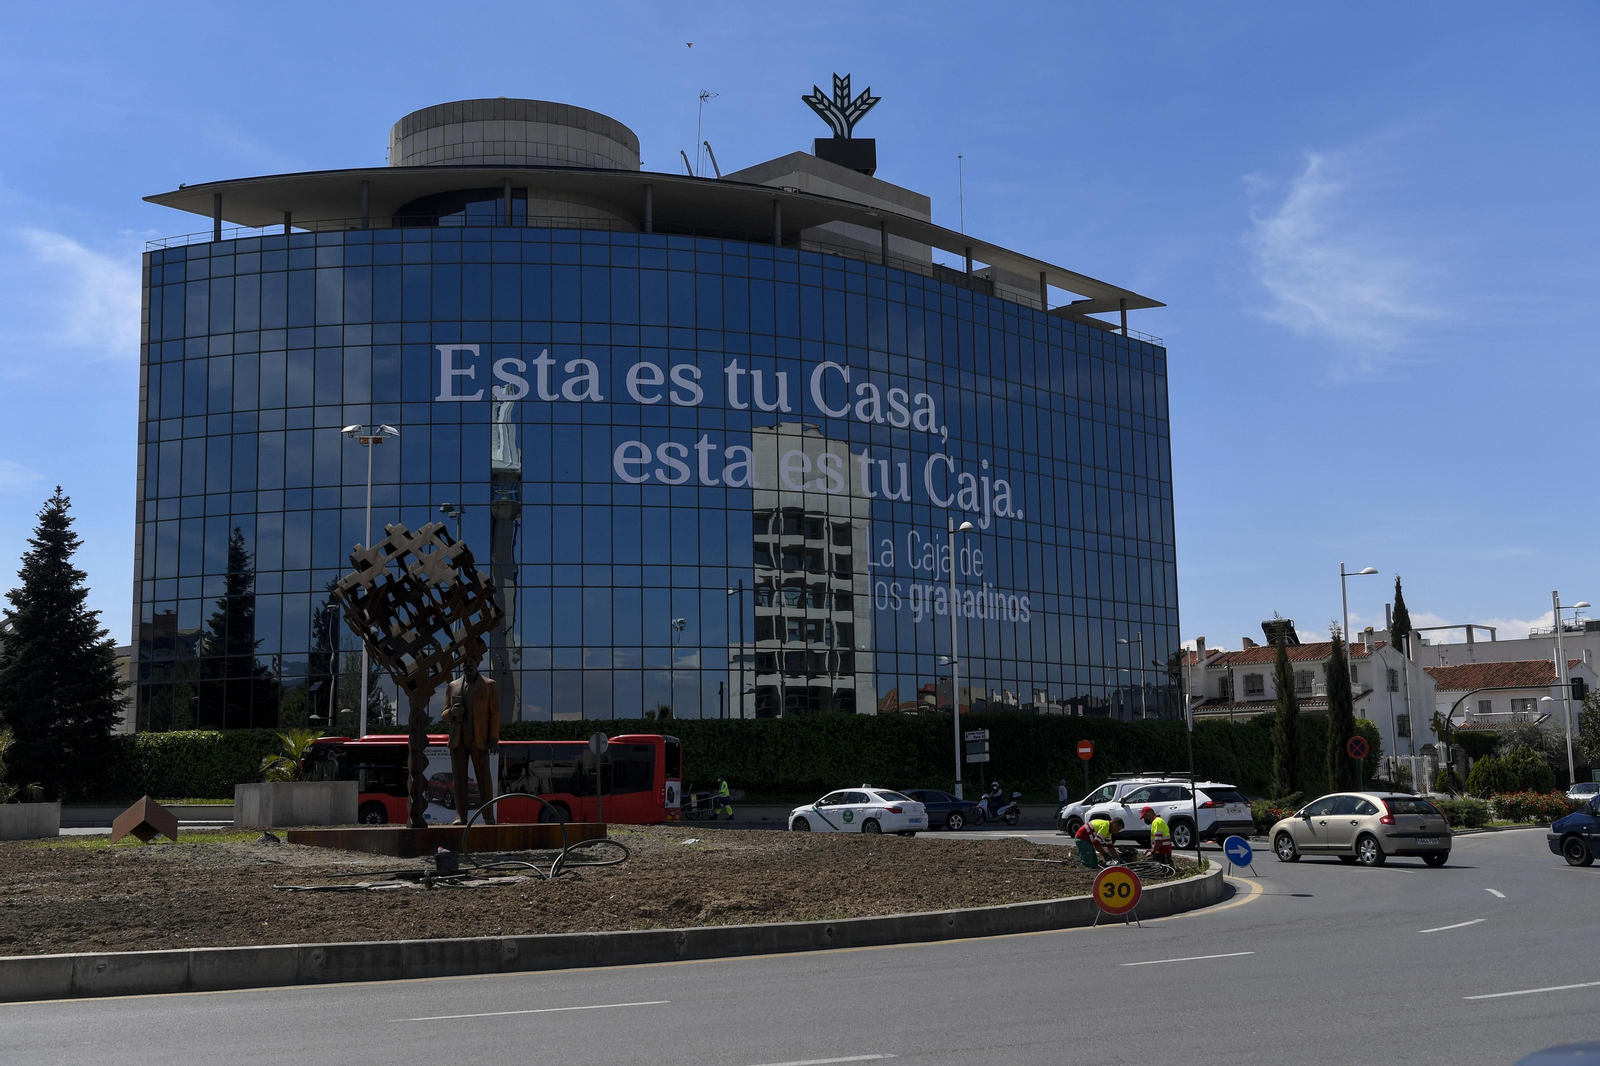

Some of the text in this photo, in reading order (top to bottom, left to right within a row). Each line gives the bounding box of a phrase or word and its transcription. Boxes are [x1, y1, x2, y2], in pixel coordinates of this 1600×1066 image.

[434, 343, 948, 444] Esta es tu Casa,
[613, 433, 1024, 530] esta es tu Caja.
[866, 526, 984, 582] La Caja de
[867, 570, 1032, 624] los granadinos
[1103, 882, 1131, 899] 30
